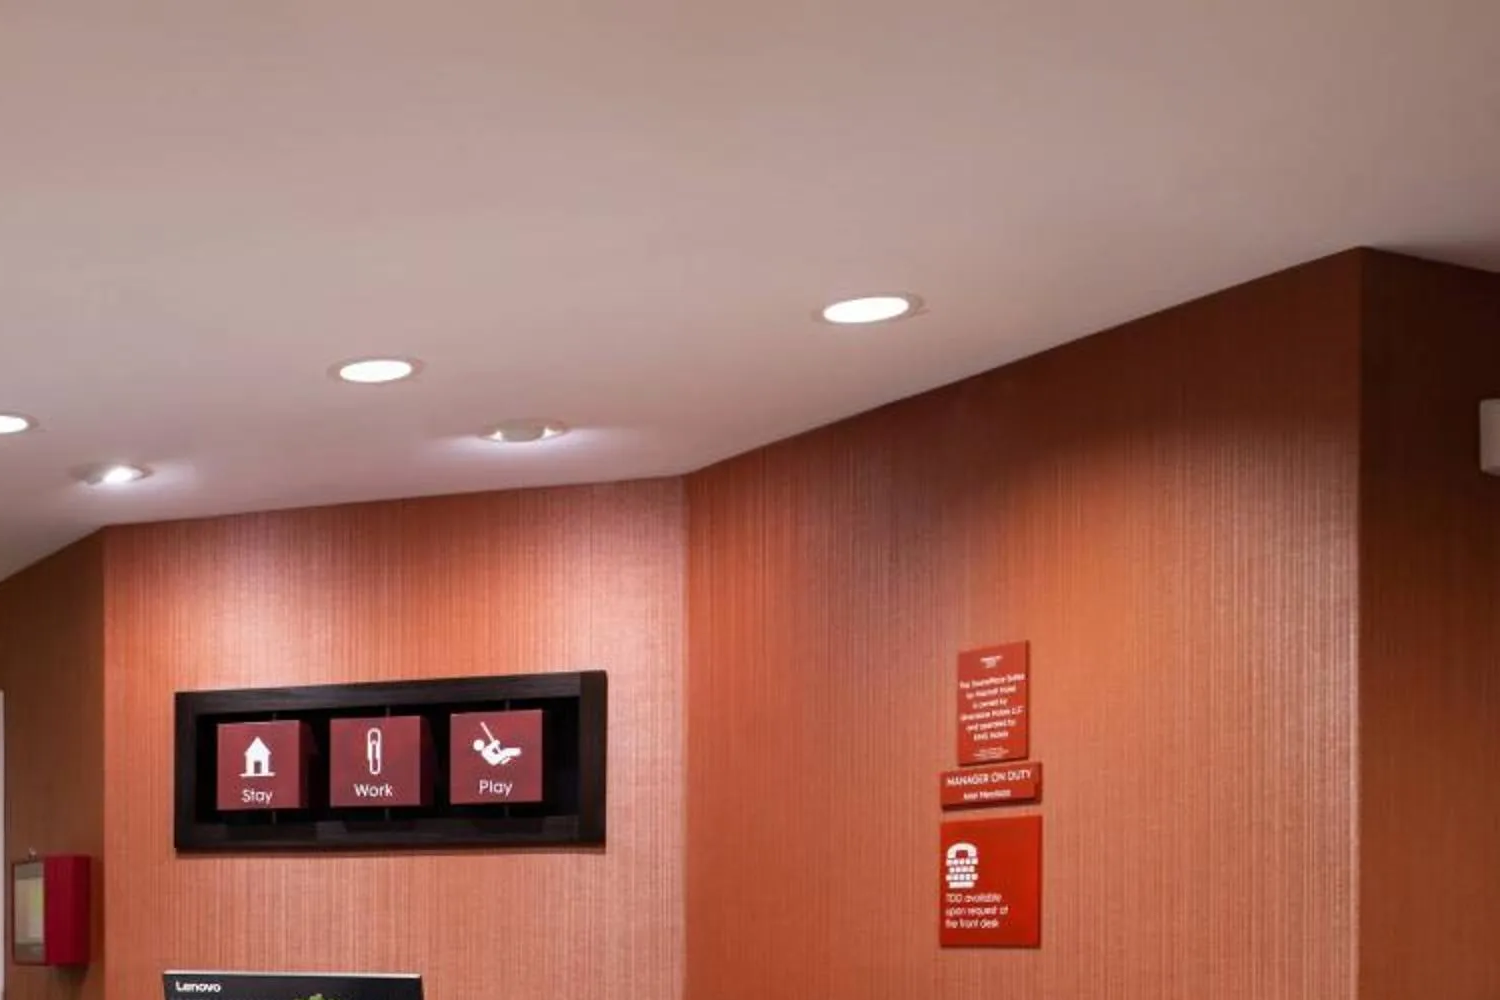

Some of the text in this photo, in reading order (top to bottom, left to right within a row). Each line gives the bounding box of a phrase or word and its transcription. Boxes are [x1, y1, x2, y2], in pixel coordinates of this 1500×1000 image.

[947, 769, 1032, 787] MANAGER ON DUTY
[354, 783, 393, 798] Work
[479, 779, 513, 796] Play
[241, 788, 273, 804] Stay
[967, 905, 997, 917] request
[980, 918, 999, 929] desk
[175, 981, 221, 993] Lenovo
